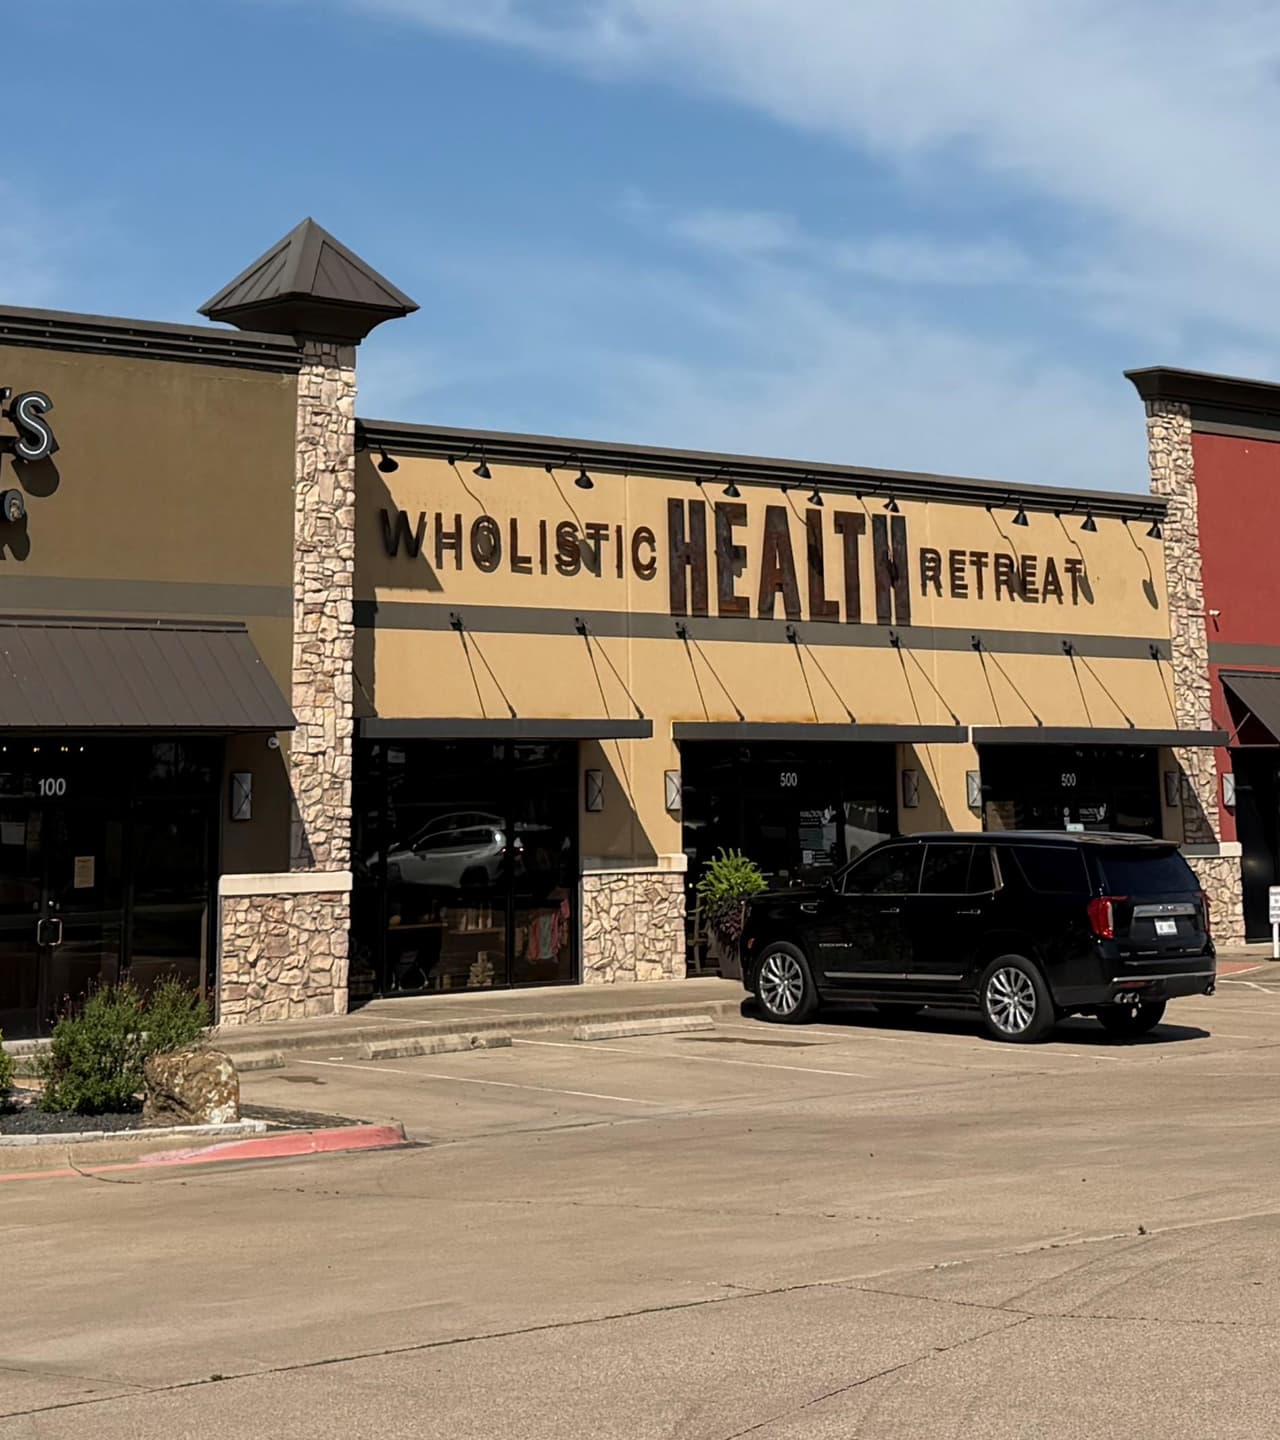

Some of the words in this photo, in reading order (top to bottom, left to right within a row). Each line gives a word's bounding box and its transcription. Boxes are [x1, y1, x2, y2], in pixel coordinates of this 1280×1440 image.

[379, 508, 657, 574] WHOLISTIC
[667, 498, 911, 626] HEALTH
[919, 547, 1083, 603] RETREAT
[38, 777, 66, 796] 100
[780, 772, 798, 787] 500
[1061, 772, 1077, 787] 500
